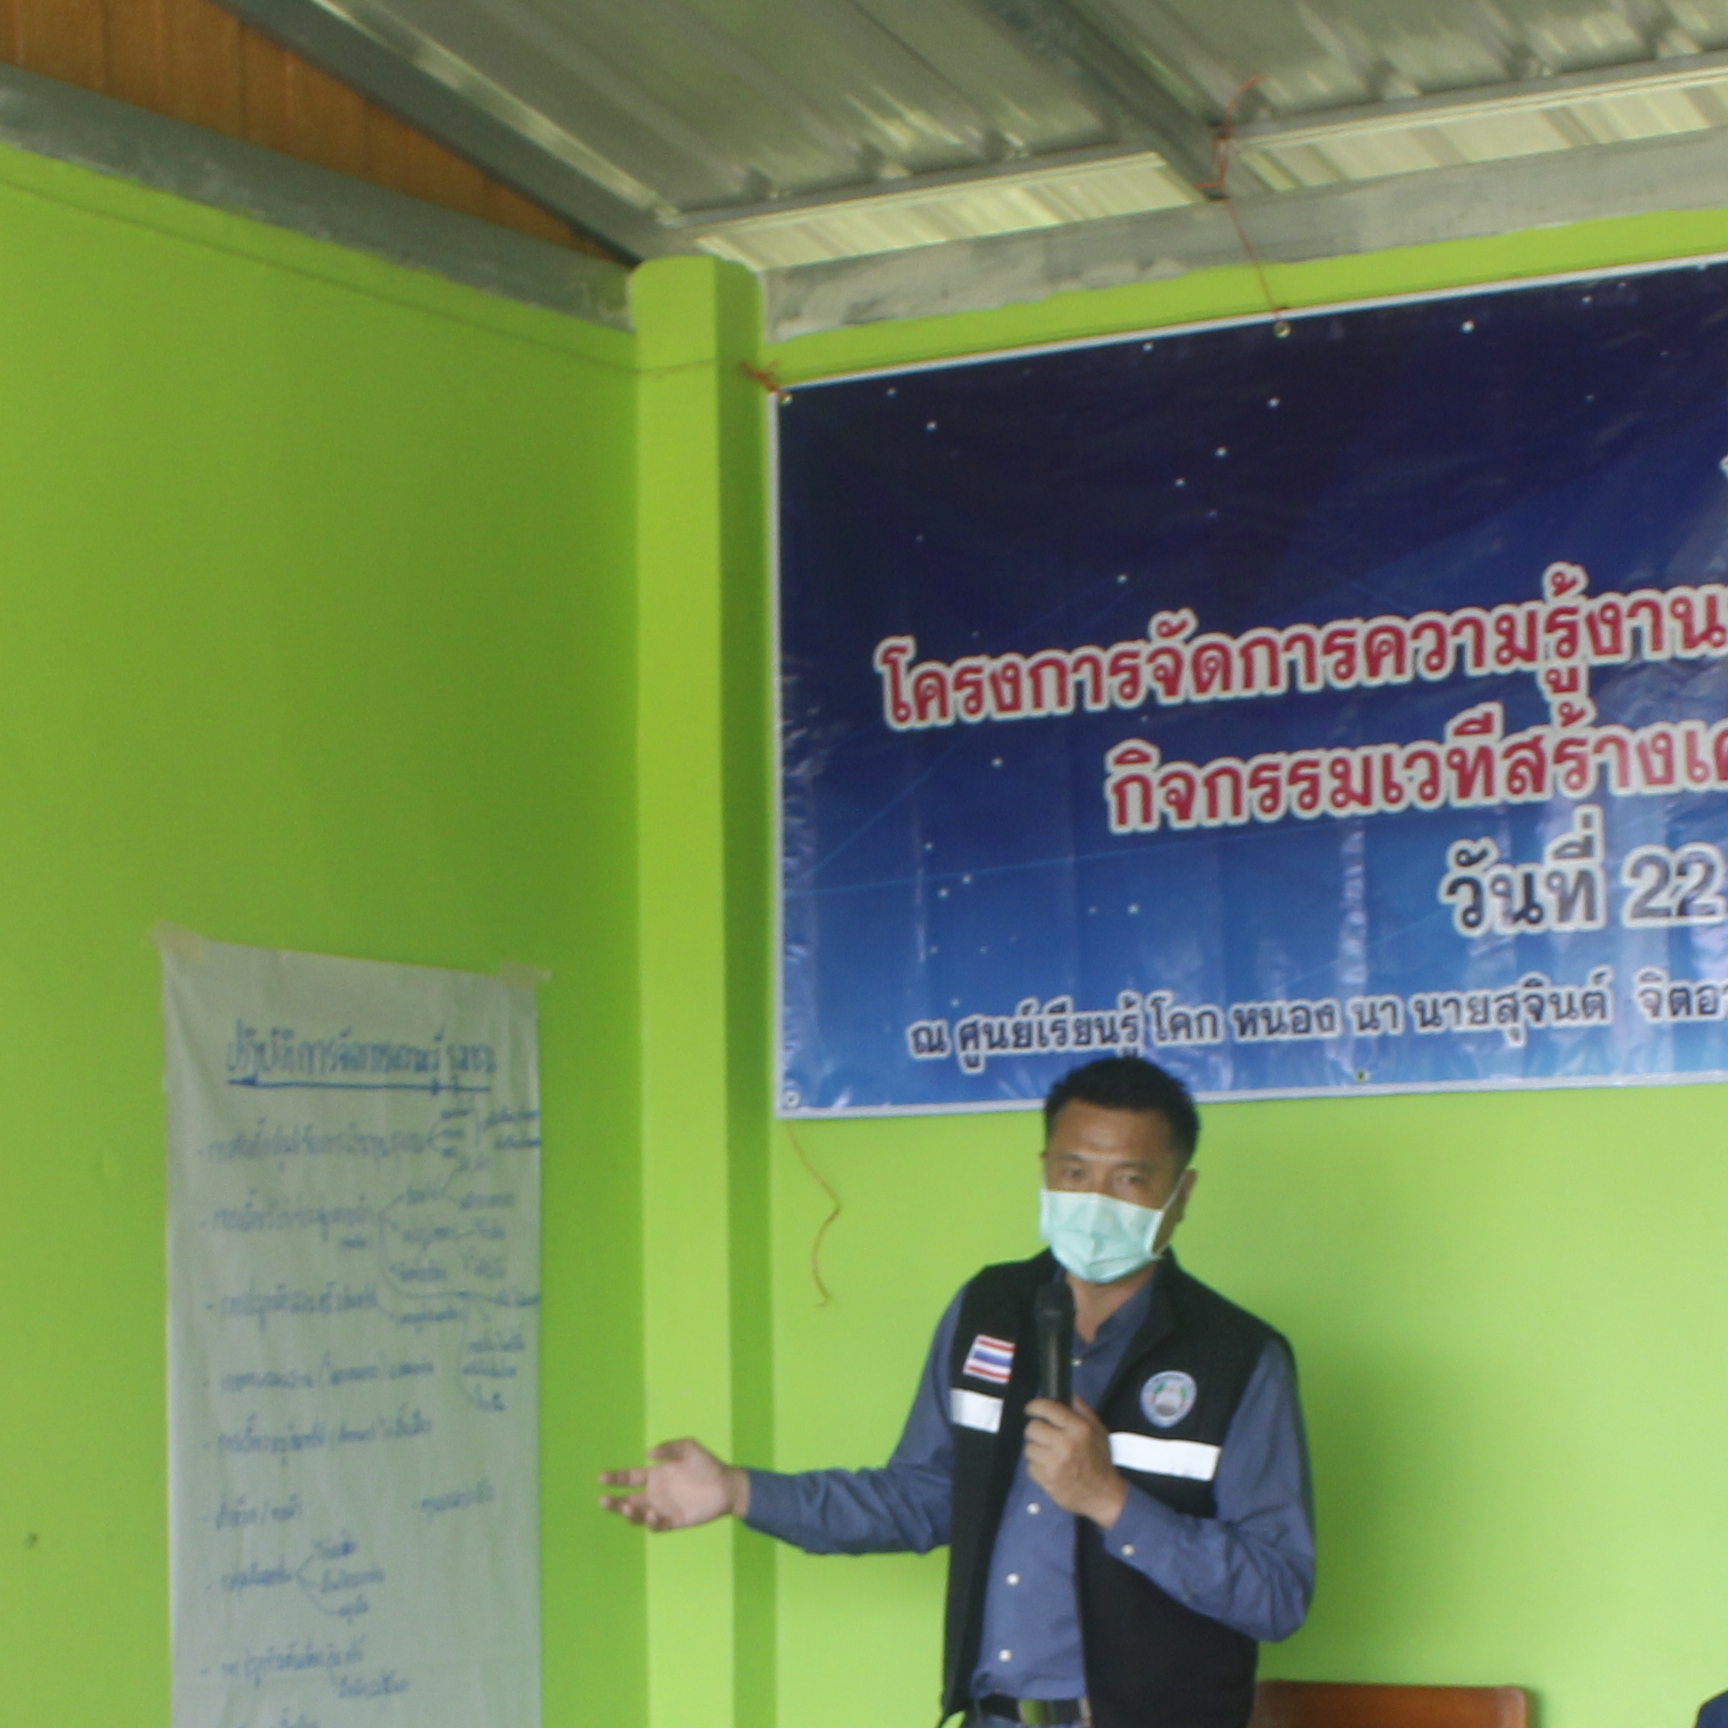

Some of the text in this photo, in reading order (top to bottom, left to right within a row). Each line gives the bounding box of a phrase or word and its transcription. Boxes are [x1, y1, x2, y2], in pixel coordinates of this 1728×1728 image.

[1447, 812, 1600, 928] วันที่
[1629, 850, 1719, 918] 22
[911, 1024, 945, 1055] ณ
[958, 995, 1140, 1070] ศูนย์เรียนรู้
[1150, 994, 1218, 1041] โคก
[1233, 1001, 1335, 1038] หนอง
[1354, 999, 1399, 1030] นา
